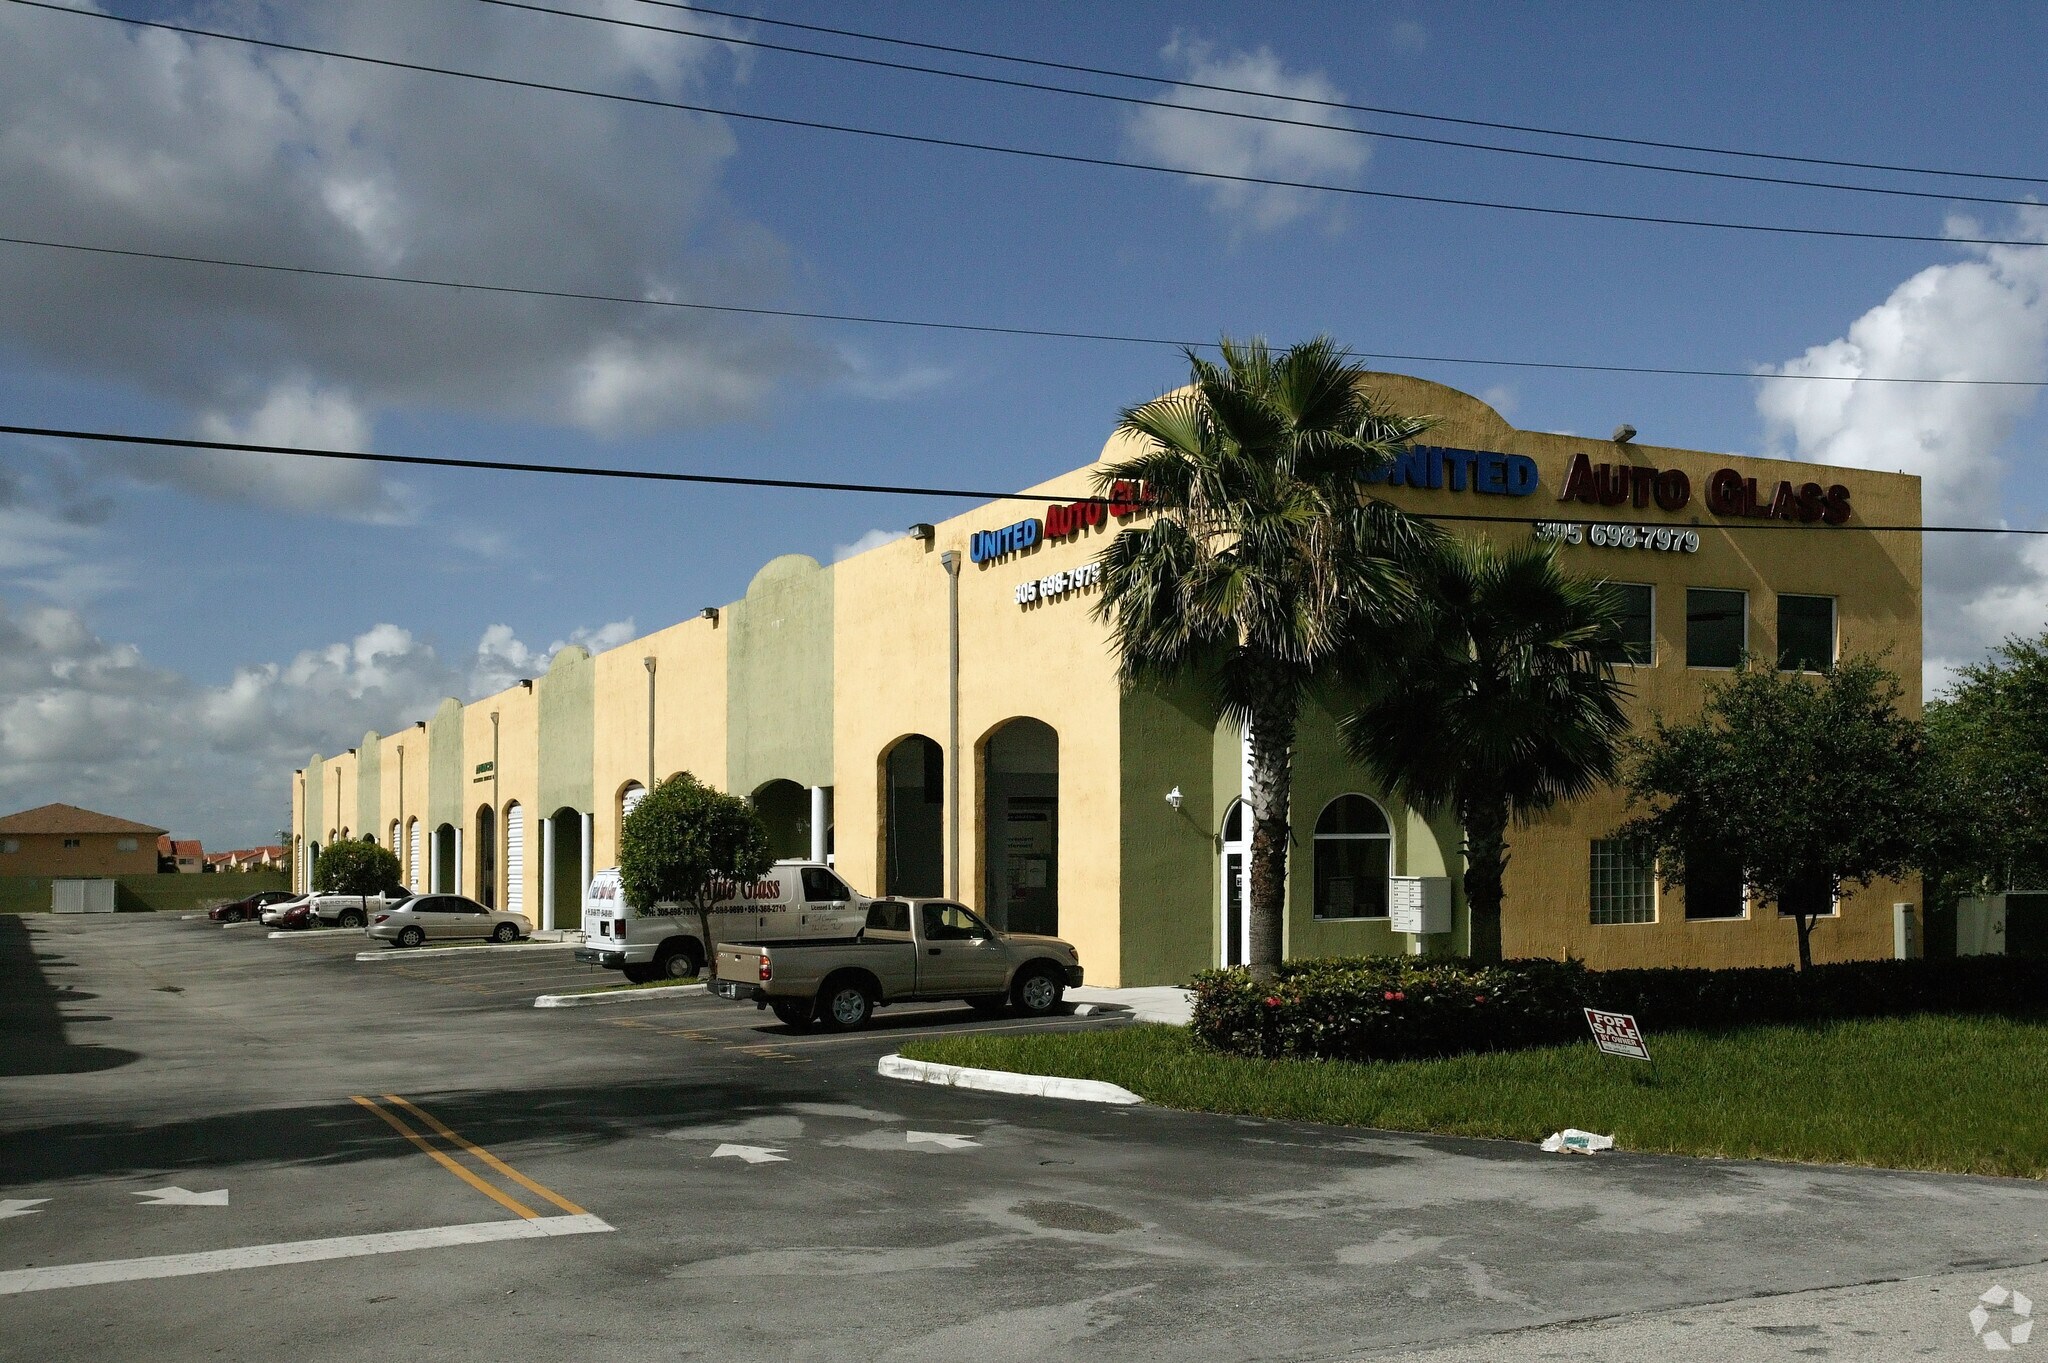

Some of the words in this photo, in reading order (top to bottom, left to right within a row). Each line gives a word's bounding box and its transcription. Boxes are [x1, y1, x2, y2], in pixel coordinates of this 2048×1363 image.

[1558, 453, 1691, 512] AUTO
[1704, 468, 1851, 525] GLASS
[970, 518, 1039, 563] UNITED
[1044, 497, 1104, 540] AUTO
[1591, 523, 1700, 553] 698-7979
[1014, 580, 1037, 605] 305
[1039, 562, 1102, 598] 698-7979
[1593, 1013, 1627, 1028] FOR
[1593, 1022, 1638, 1040] SALE
[1600, 1034, 1611, 1042] BY
[1612, 1036, 1638, 1046] OWNER
